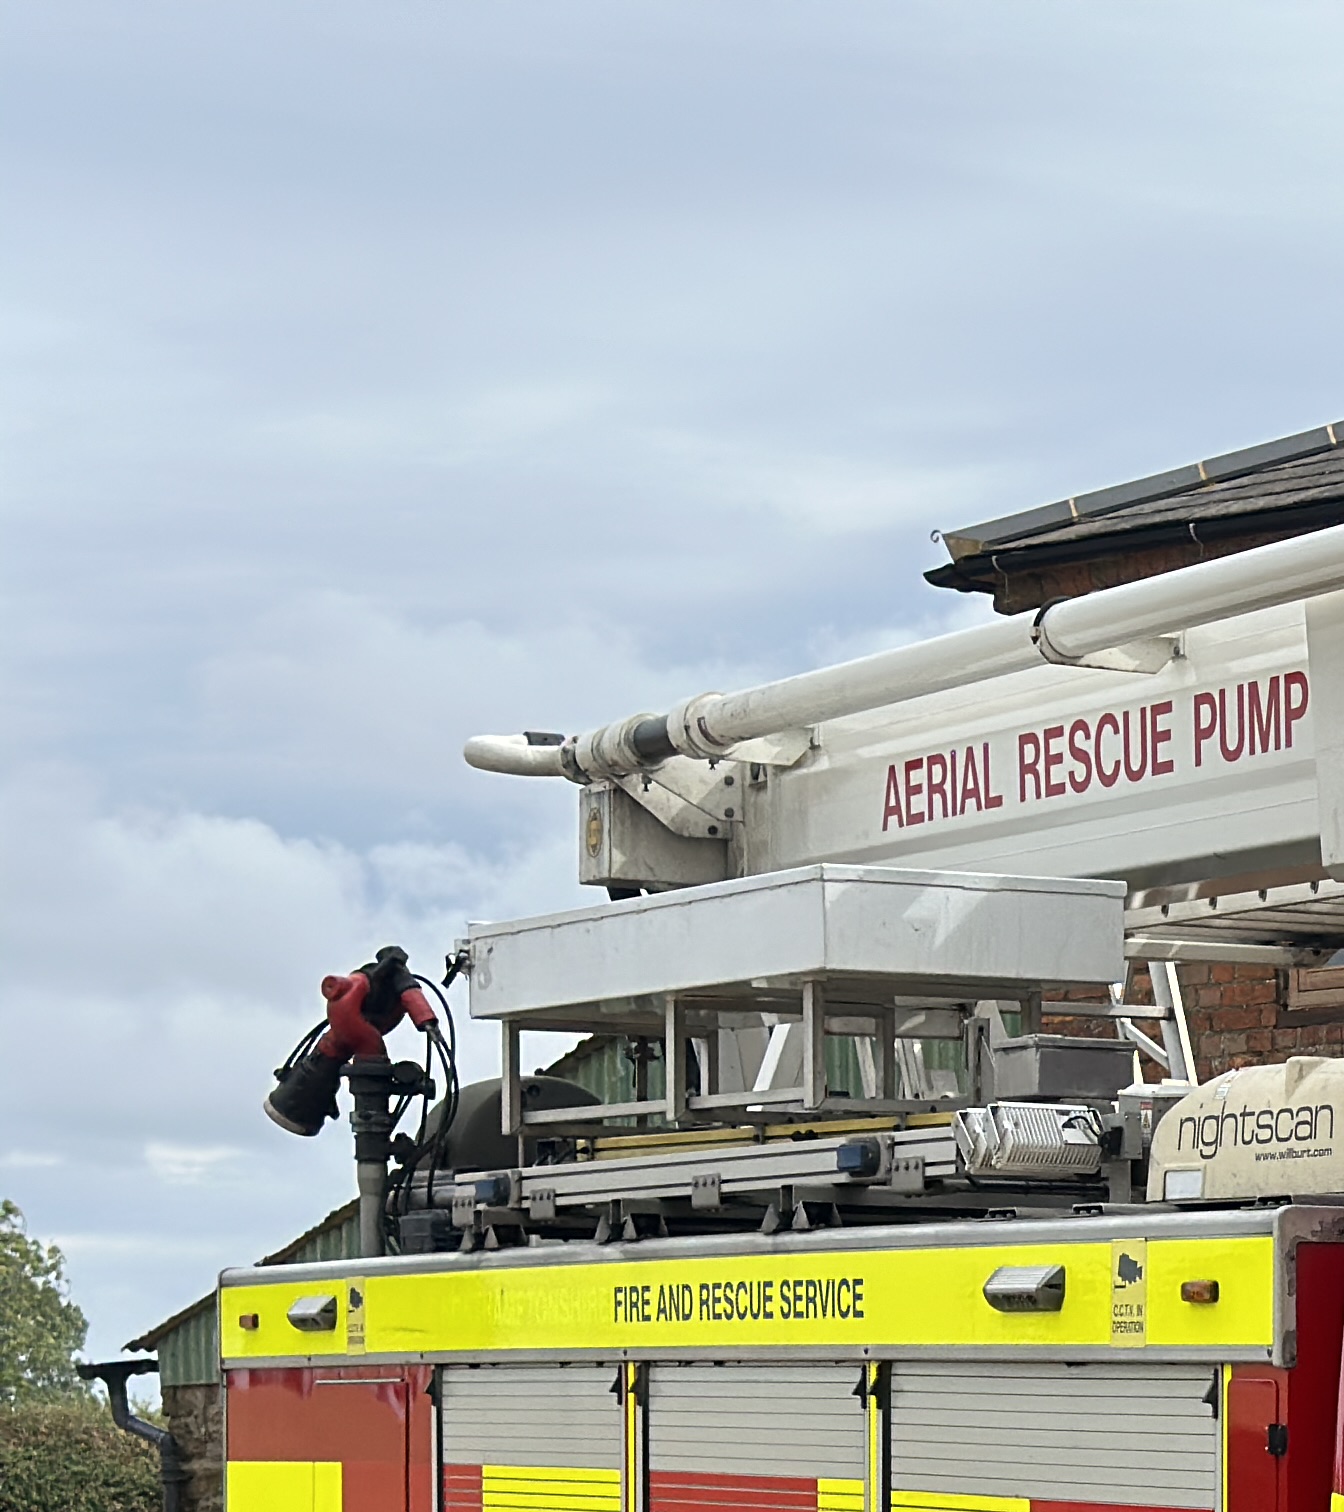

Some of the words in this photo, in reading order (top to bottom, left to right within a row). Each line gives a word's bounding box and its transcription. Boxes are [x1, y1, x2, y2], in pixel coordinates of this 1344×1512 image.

[882, 742, 1003, 832] AERIAL
[1018, 700, 1175, 803] RESCUE
[1194, 670, 1310, 768] PUMP
[1178, 1100, 1334, 1160] nightscan
[614, 1285, 651, 1323] FIRE
[656, 1283, 693, 1323] AND
[699, 1280, 774, 1321] RESCUE
[779, 1278, 865, 1320] SERVICE
